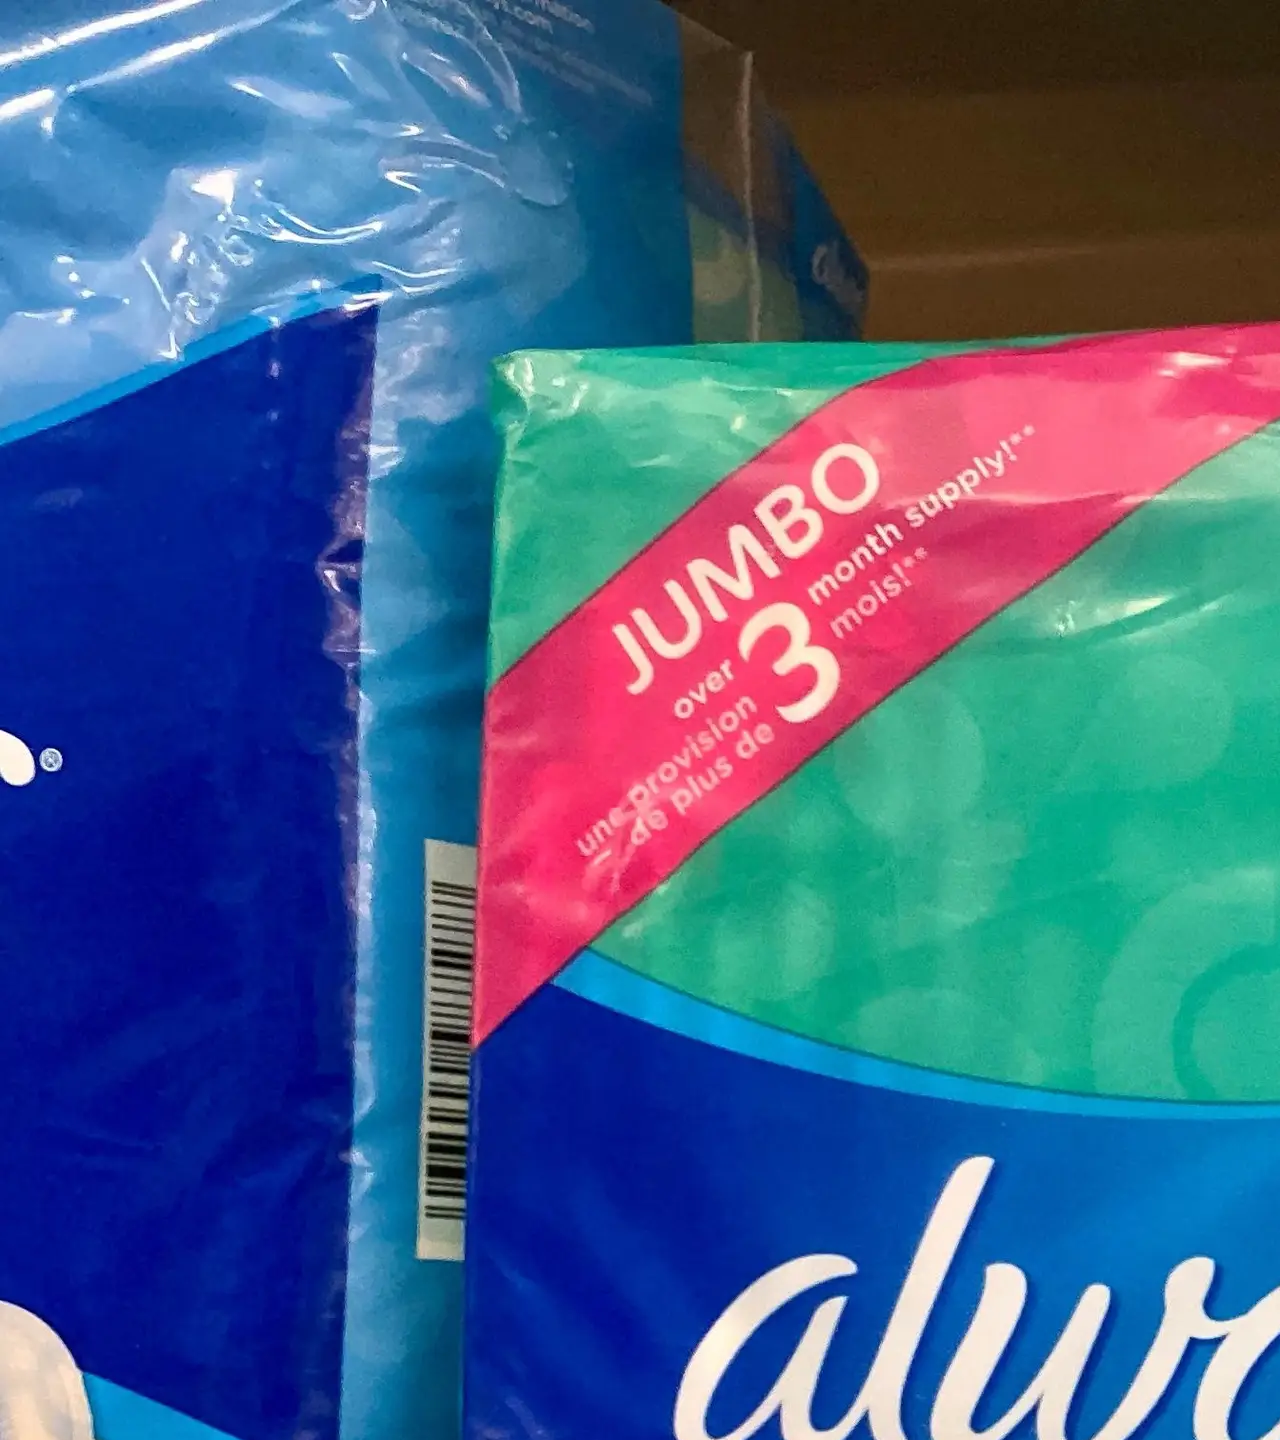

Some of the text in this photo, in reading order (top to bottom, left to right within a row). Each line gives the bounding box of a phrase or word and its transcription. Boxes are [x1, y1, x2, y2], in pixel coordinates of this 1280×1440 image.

[611, 442, 881, 695] JUMBO
[674, 659, 734, 719] over
[738, 602, 840, 723] 3
[807, 522, 903, 607] month
[628, 696, 758, 808] provision
[630, 723, 775, 846] de plus de
